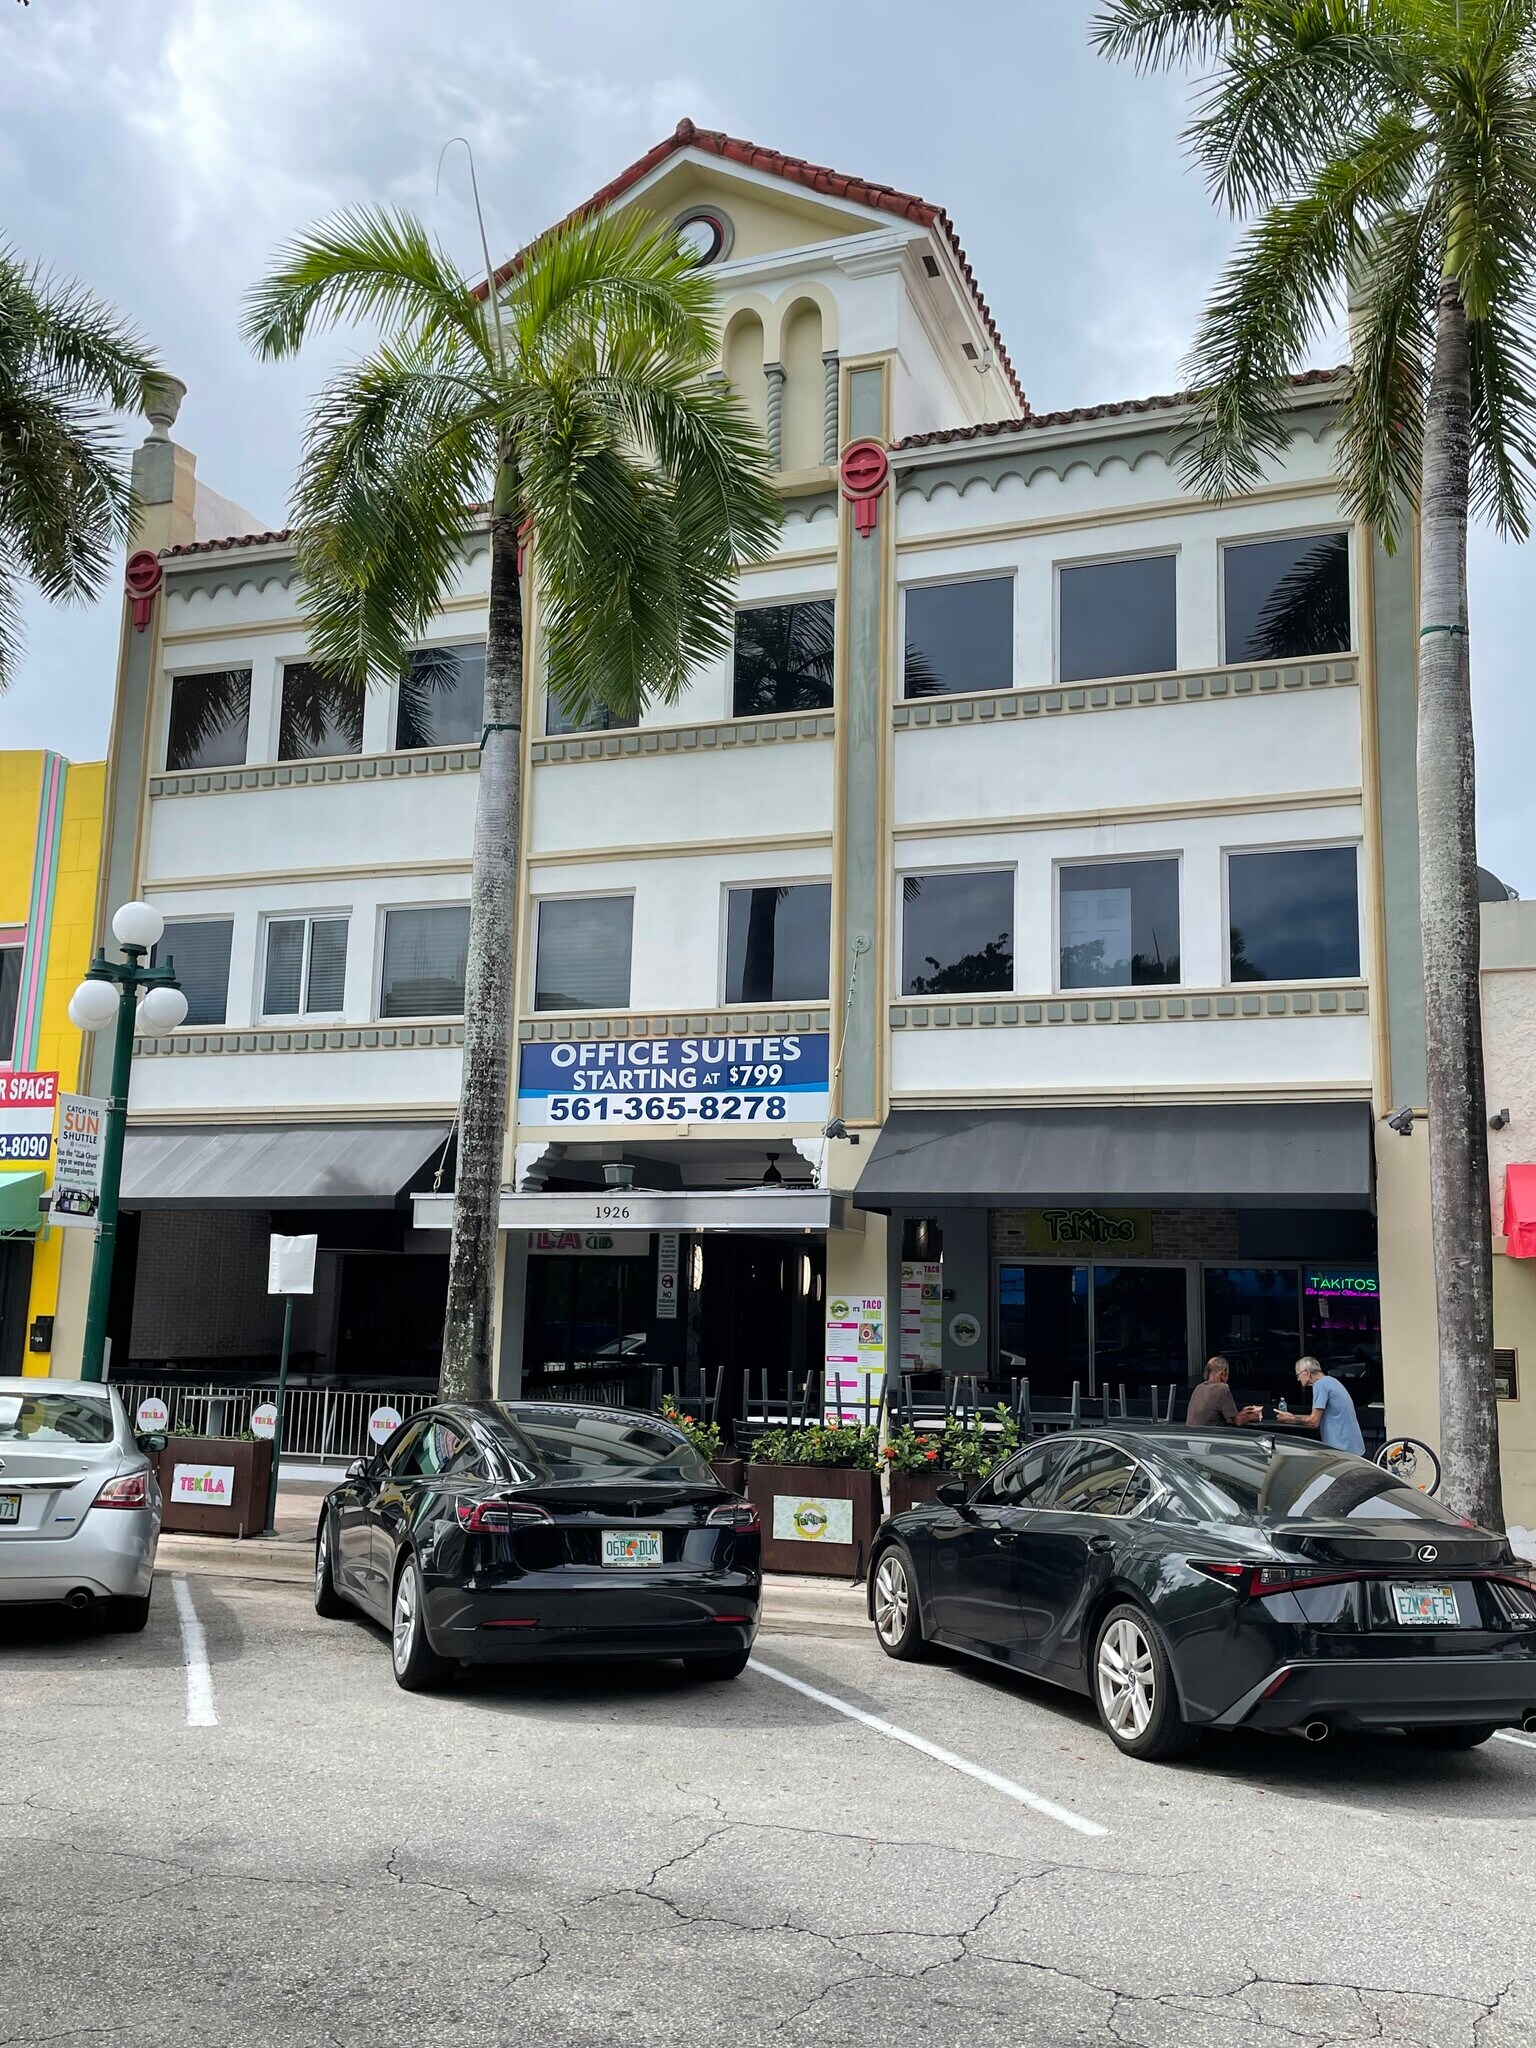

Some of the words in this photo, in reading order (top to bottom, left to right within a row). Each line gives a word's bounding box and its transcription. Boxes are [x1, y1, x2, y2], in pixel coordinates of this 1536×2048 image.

[550, 1041, 669, 1068] OFFICE
[681, 1036, 802, 1064] SUITES
[573, 1067, 697, 1091] STARTING
[702, 1072, 720, 1085] AT
[729, 1064, 783, 1086] $799
[9, 1077, 55, 1100] SPACE
[67, 1105, 87, 1115] CATCH
[88, 1108, 99, 1117] THE
[550, 1095, 787, 1121] 561-365-8278
[64, 1112, 100, 1135] SUN
[63, 1131, 98, 1144] SHUTTLE
[595, 1206, 630, 1219] 1926
[924, 1265, 940, 1273] TACO
[1310, 1277, 1377, 1291] TAKITOS
[862, 1300, 882, 1309] TACO
[639, 1540, 659, 1555] DUK
